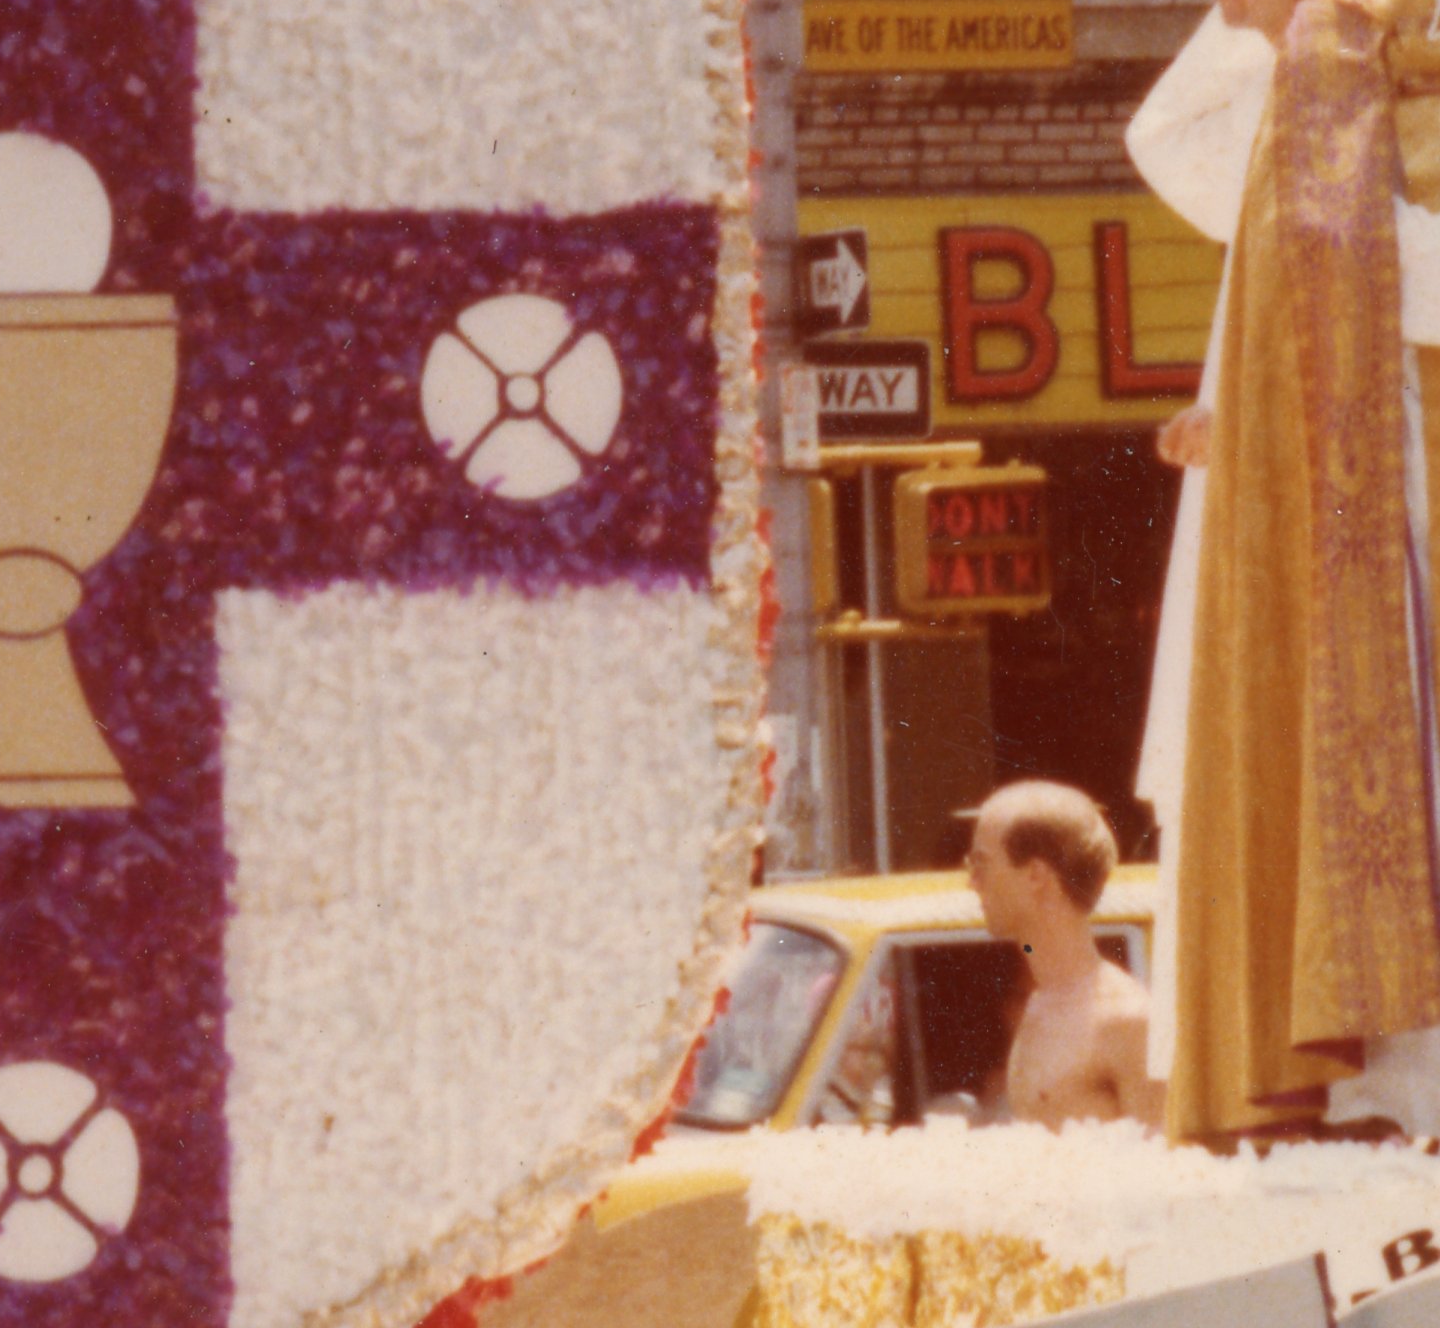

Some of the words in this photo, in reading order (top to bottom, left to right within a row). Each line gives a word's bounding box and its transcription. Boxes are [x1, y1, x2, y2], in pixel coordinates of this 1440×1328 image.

[806, 16, 847, 54] AVE
[857, 16, 884, 52] OF
[896, 16, 939, 52] THE
[944, 14, 1066, 52] AMERICAS
[819, 371, 903, 408] WAY
